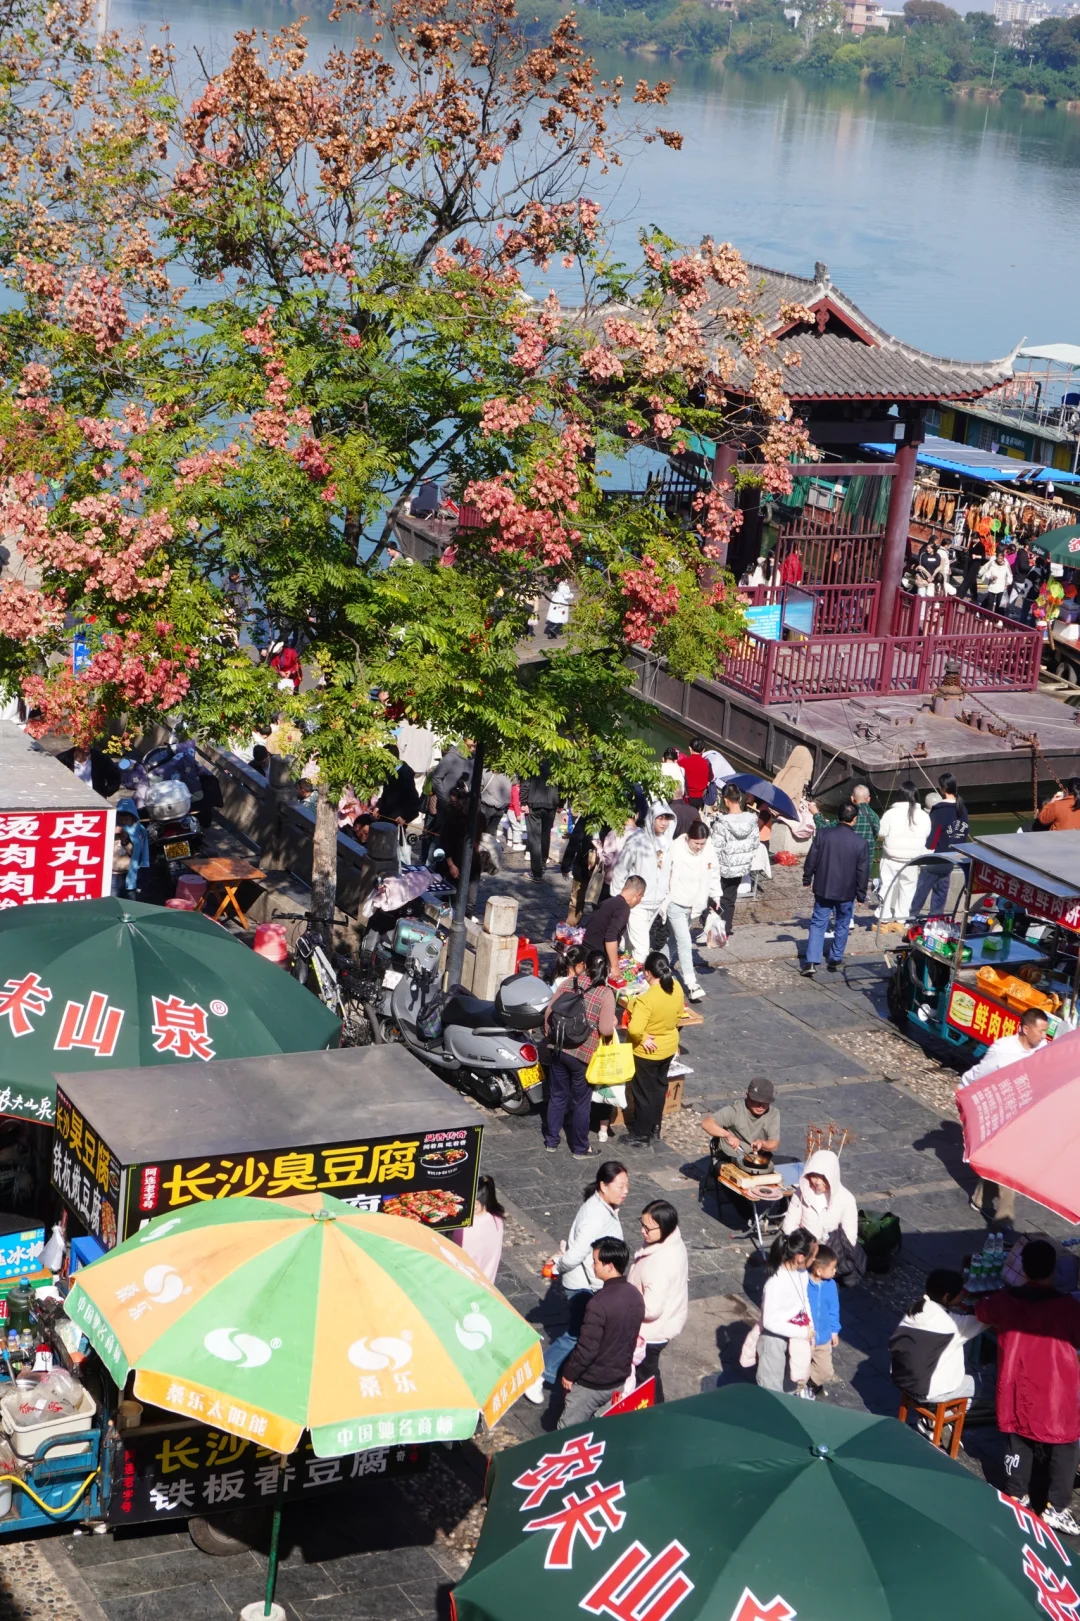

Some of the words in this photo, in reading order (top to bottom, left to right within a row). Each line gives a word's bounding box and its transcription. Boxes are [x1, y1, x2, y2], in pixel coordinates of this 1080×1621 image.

[0, 841, 101, 869] 肉丸
[0, 868, 97, 897] 肉片
[56, 1101, 112, 1193] 长沙臭豆腐
[162, 1140, 420, 1206] 长沙臭豆腐
[358, 1371, 418, 1398] 桑乐
[166, 1383, 269, 1437] 桑乐太阳能
[337, 1415, 454, 1449] 中国驰名商标
[150, 1445, 391, 1511] 铁板香豆腐
